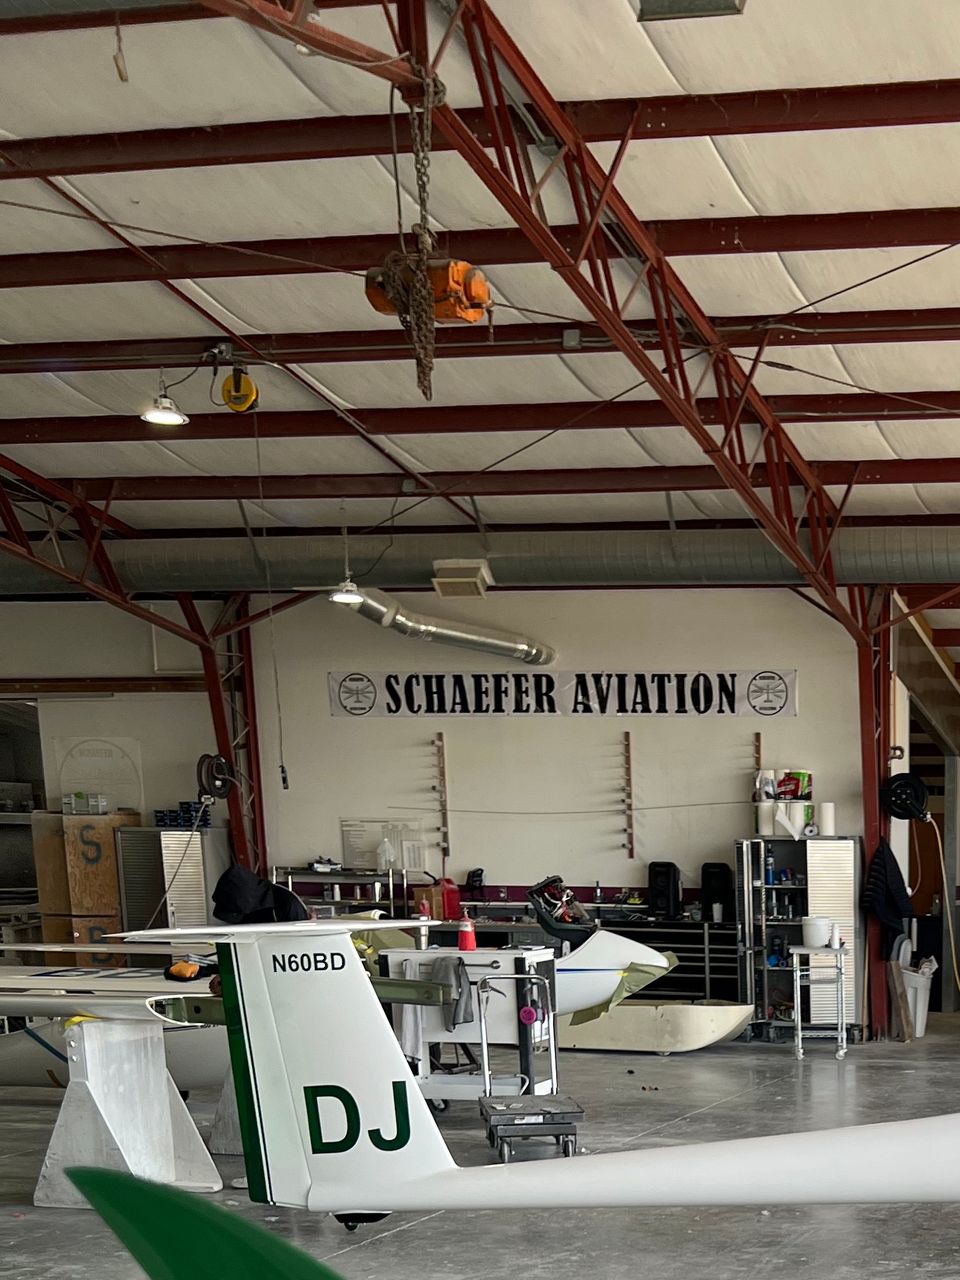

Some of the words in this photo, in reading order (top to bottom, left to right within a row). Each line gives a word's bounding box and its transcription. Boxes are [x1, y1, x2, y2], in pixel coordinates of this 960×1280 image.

[385, 673, 557, 714] SCHAEFER
[572, 672, 737, 714] AVIATION
[80, 824, 102, 865] S
[272, 952, 346, 973] N60BD
[303, 1080, 411, 1155] DJ
